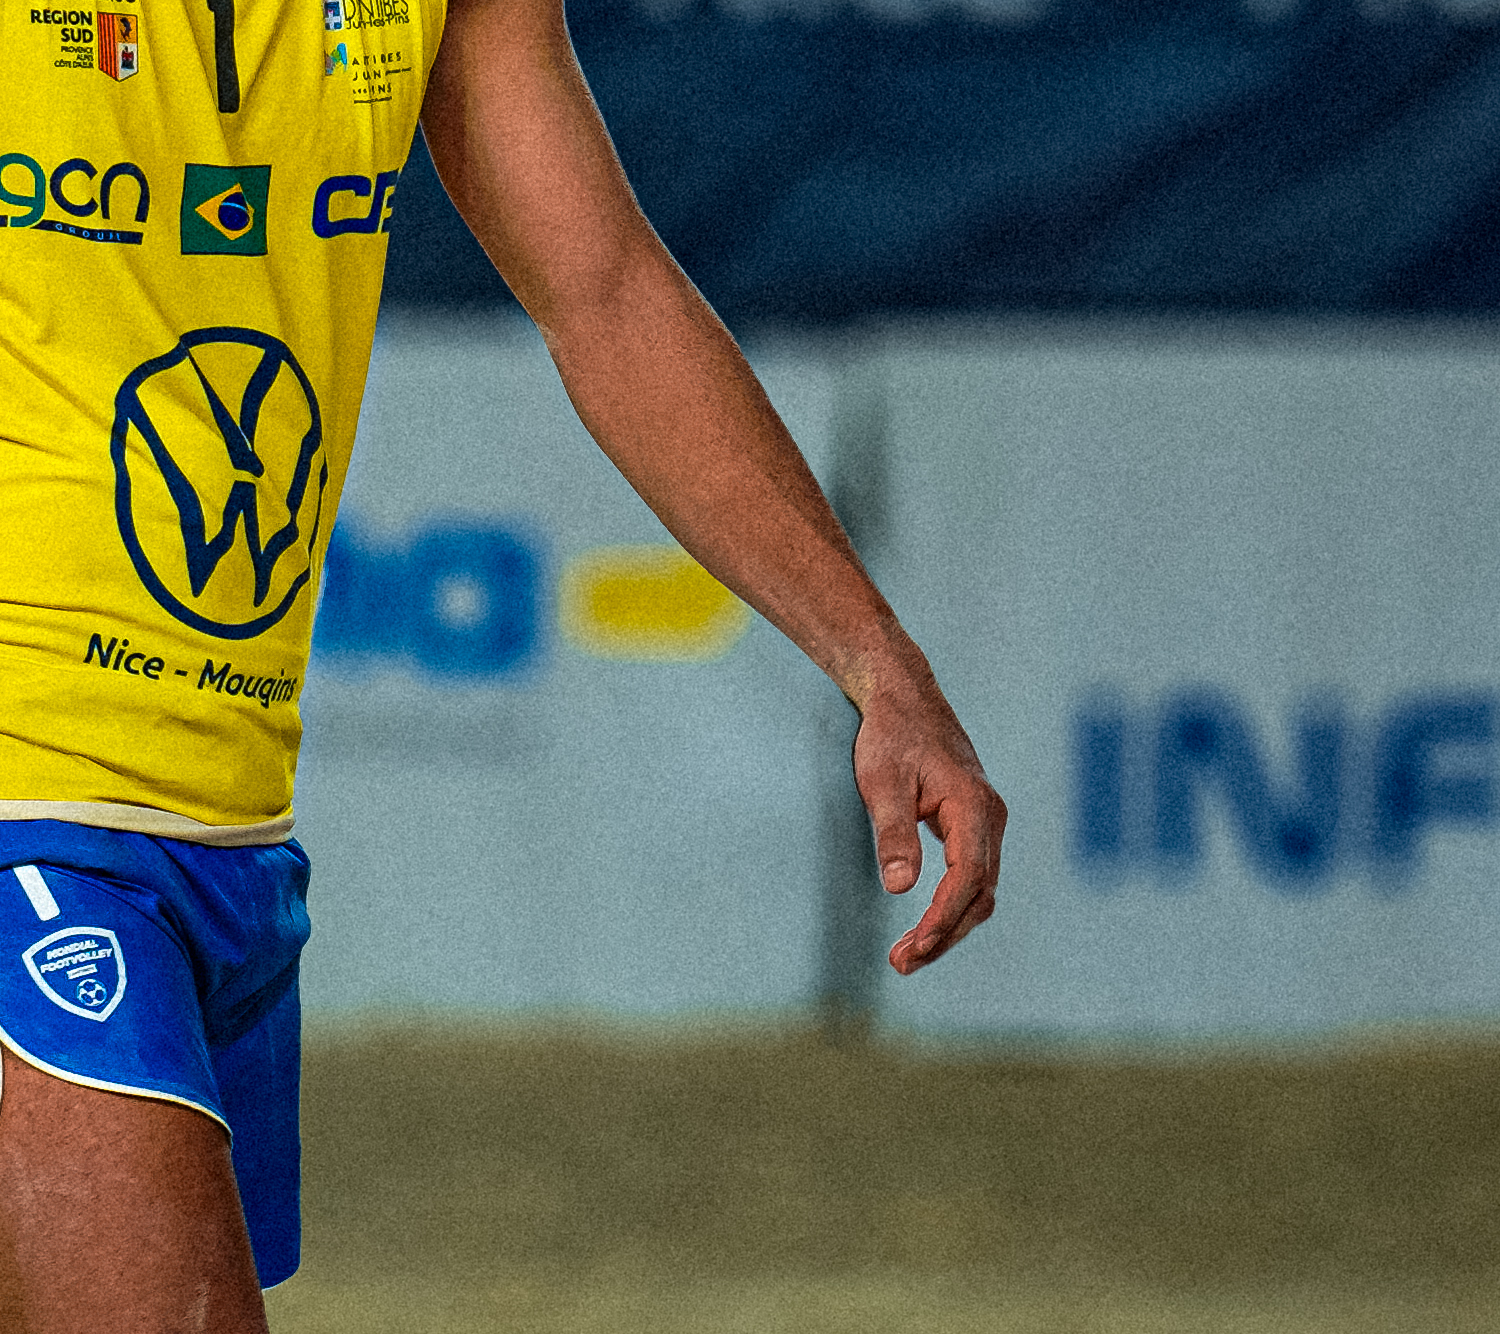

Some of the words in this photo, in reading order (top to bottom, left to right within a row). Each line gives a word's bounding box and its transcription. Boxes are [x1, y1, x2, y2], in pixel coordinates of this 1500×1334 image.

[60, 27, 94, 44] SUD
[83, 632, 166, 681] Nice
[197, 658, 298, 710] Mougins
